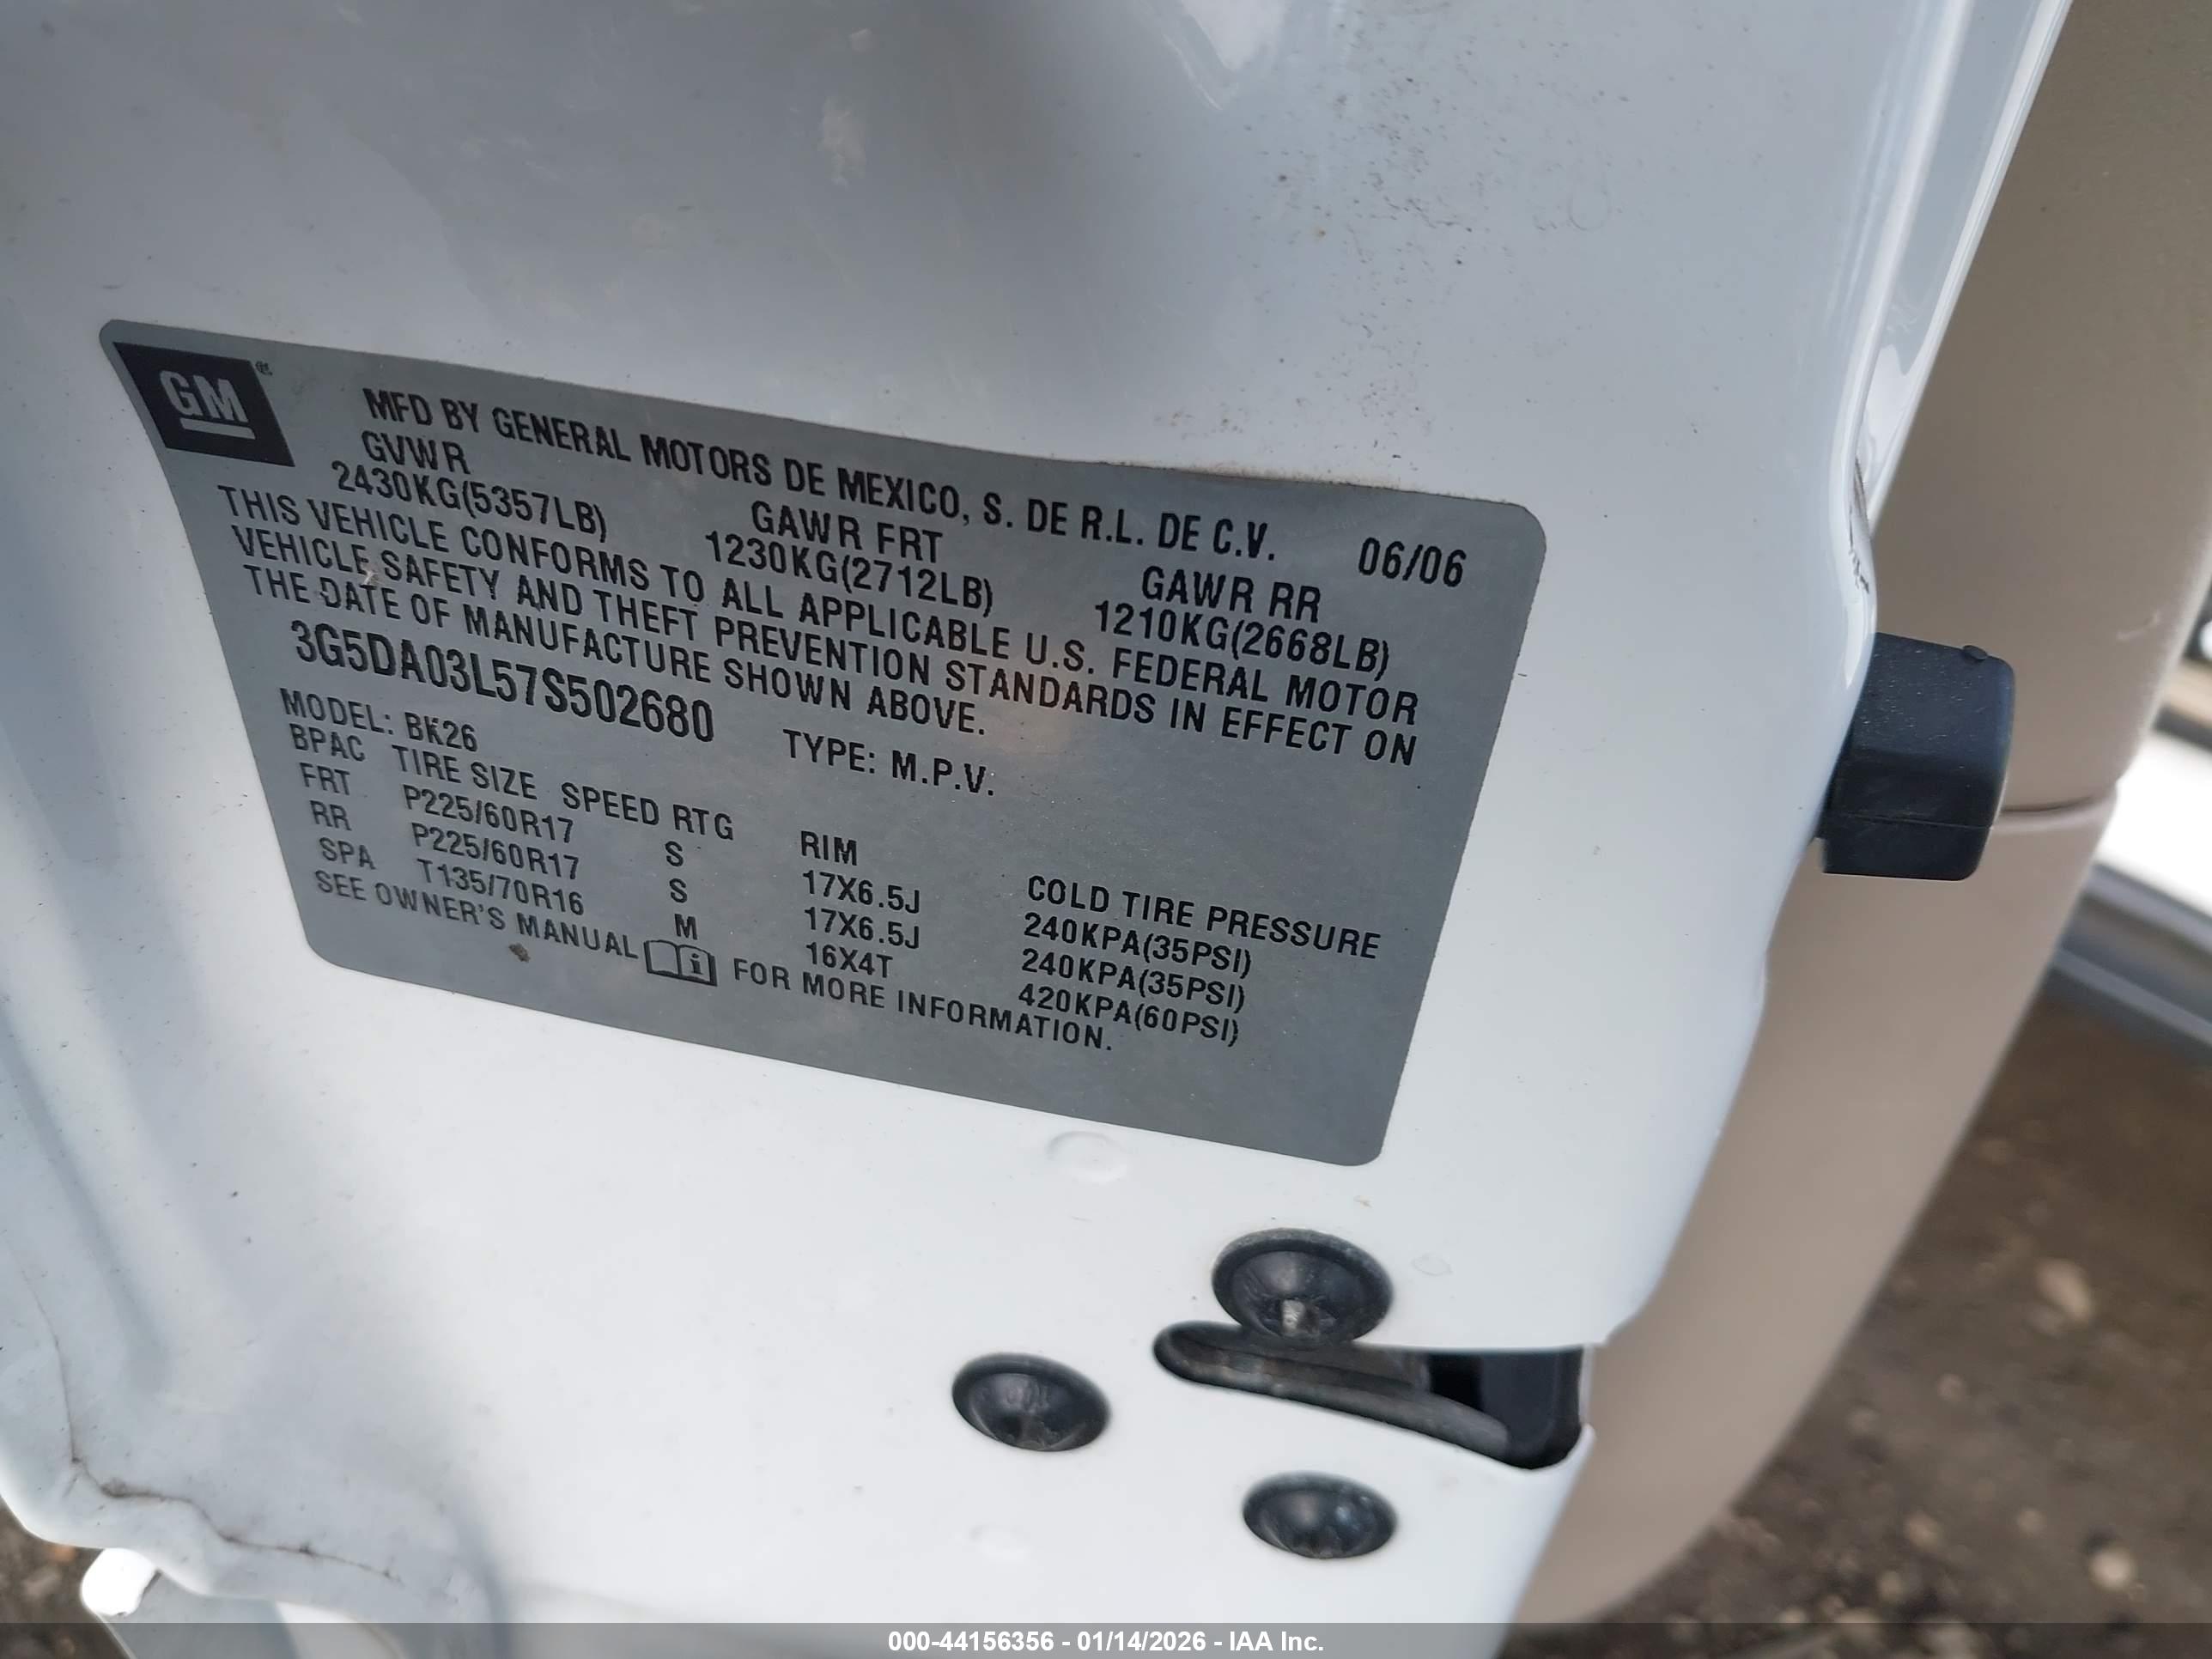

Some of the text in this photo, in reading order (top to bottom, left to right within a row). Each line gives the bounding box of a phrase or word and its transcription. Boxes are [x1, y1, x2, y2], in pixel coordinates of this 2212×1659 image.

[158, 370, 248, 422] GM
[362, 430, 471, 474] GVWR
[362, 388, 1468, 590] MFD BY GENERAL MOTORS DE MEXICO, S. DE R.L. DE C.V. 06/06
[331, 460, 607, 542] 2430KG(5357LB)
[750, 501, 945, 564] GAWR FRT
[218, 485, 1419, 726] THIS VEHICLE CONFORMS TO ALL APPLICABLE U.S. FEDERAL MOTOR
[704, 532, 995, 618] 1230KG(2712LB)
[1141, 565, 1322, 623] GAWR RR
[232, 525, 1418, 766] VEHICLE SAFETY AND THEFT PREVENTION STANDARDS IN EFFECT ON
[244, 565, 986, 735] THE DATE OF MANUFACTURE SHOWN ABOVE.
[290, 620, 714, 742] 3G5DA03L57S502680
[1095, 600, 1391, 681] 1210KG(2668LB)
[280, 688, 479, 751] MODEL: BK26
[783, 729, 995, 796] TYPE: M.P.V.
[290, 723, 735, 841] BPAC TIRE SIZE SPEED RTG
[299, 763, 1252, 980] FRT P225/60R17 S 17X6.5J 240KPA(35PSI)
[801, 831, 857, 866] RIM
[310, 800, 1245, 1013] RR P225/60R17 S 17X6.5J 240KPA(35PSI)
[319, 838, 1238, 1048] SPA T135/70R16 M 16X4T 420KPA(60PSI)
[1028, 875, 1382, 960] COLD TIRE PRESSURE
[314, 871, 1114, 1051] SEE OWNER'S MANUAL FOR MORE INFORMATION.
